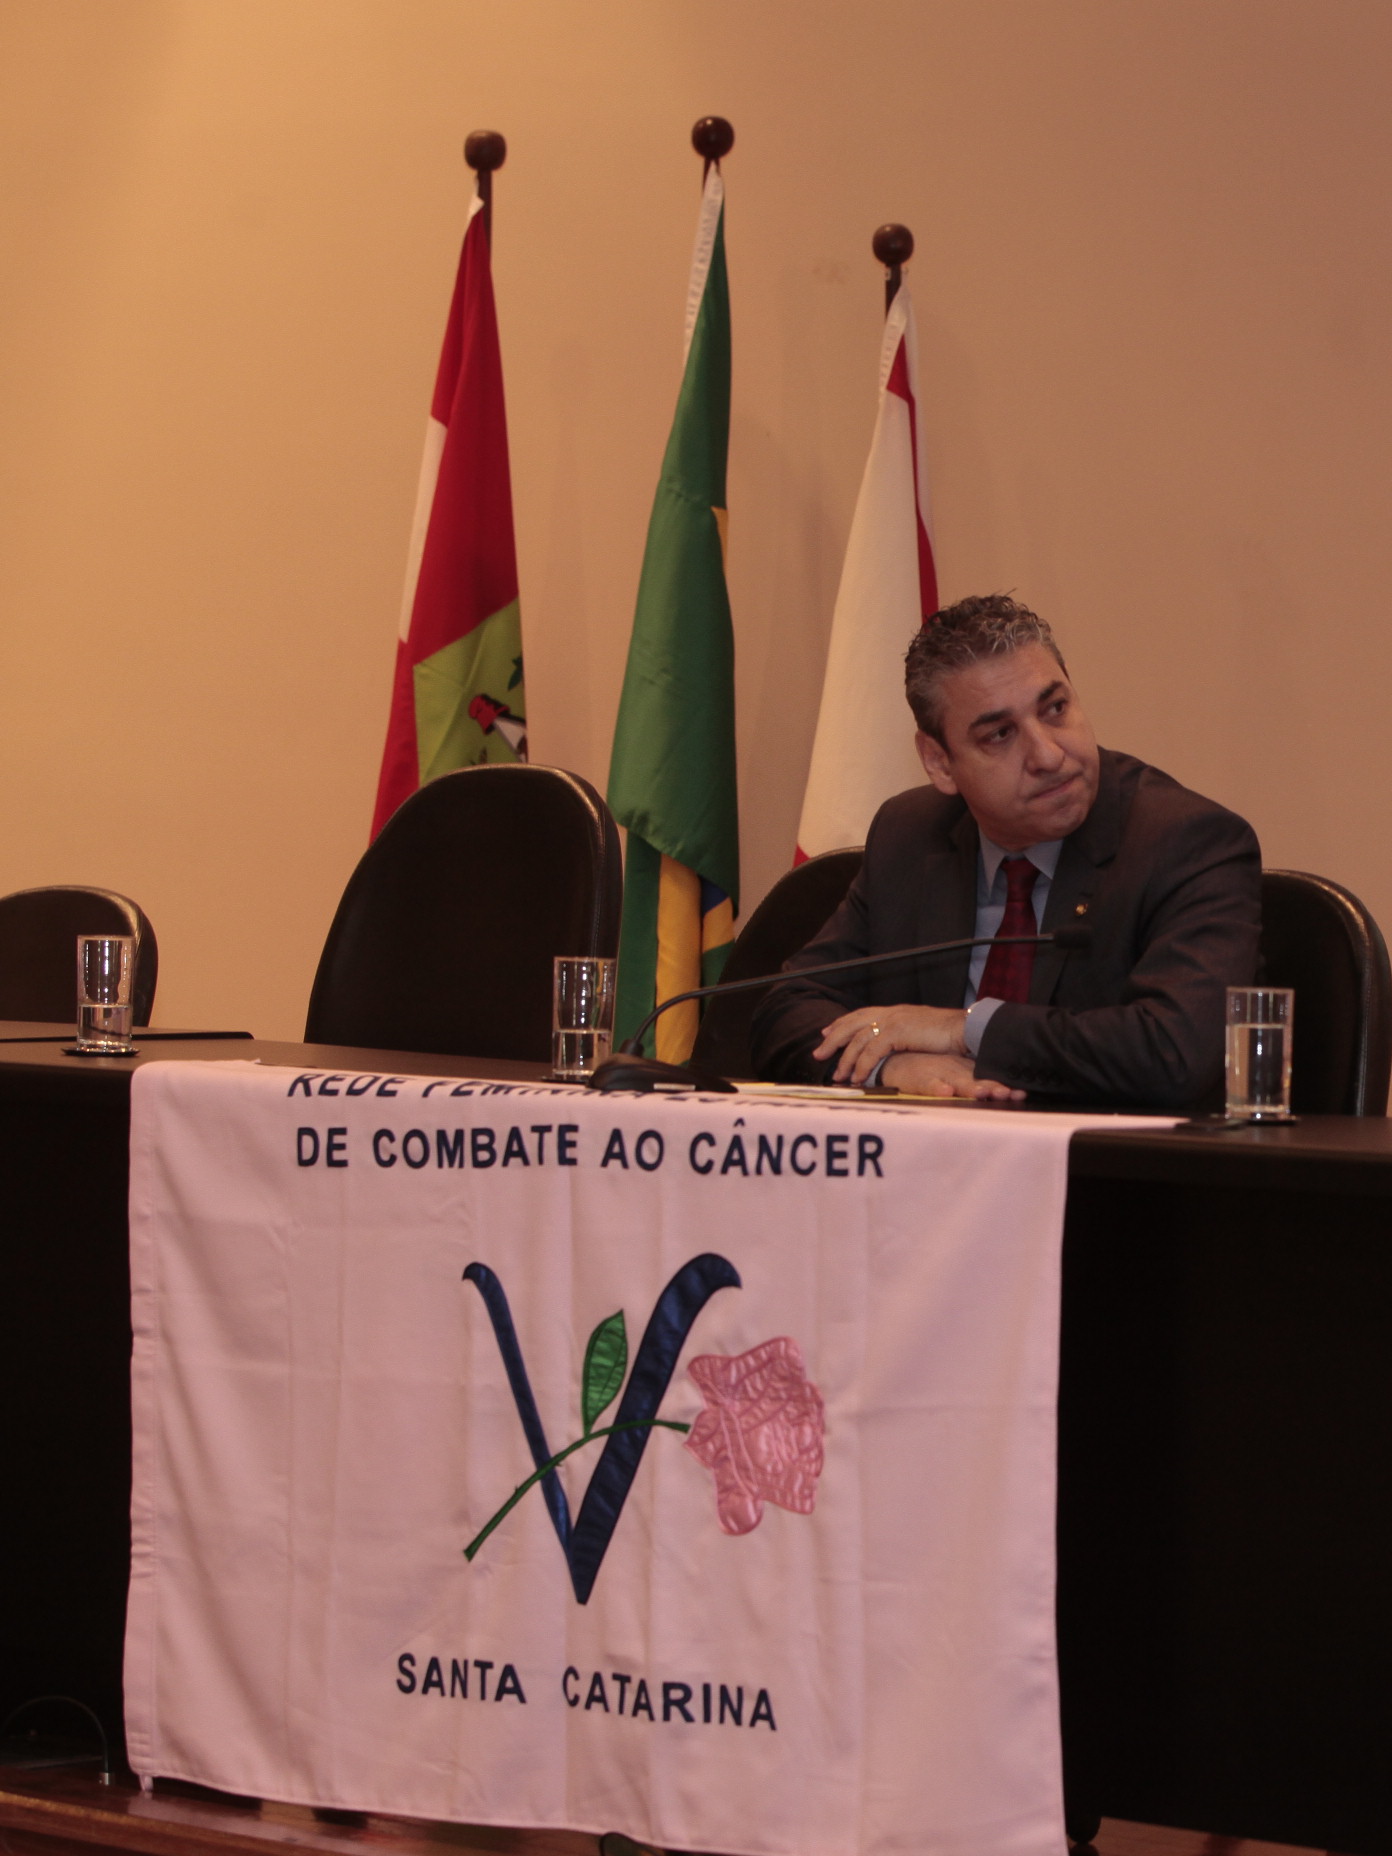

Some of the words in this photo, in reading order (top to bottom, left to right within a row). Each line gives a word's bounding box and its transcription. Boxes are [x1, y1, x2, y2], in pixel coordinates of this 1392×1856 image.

[287, 1073, 415, 1098] REDE
[297, 1126, 349, 1168] DE
[372, 1123, 580, 1169] COMBATE
[600, 1127, 665, 1172] AO
[688, 1117, 885, 1178] CÂNCER
[396, 1652, 527, 1705] SANTA
[562, 1665, 778, 1732] CATARINA
